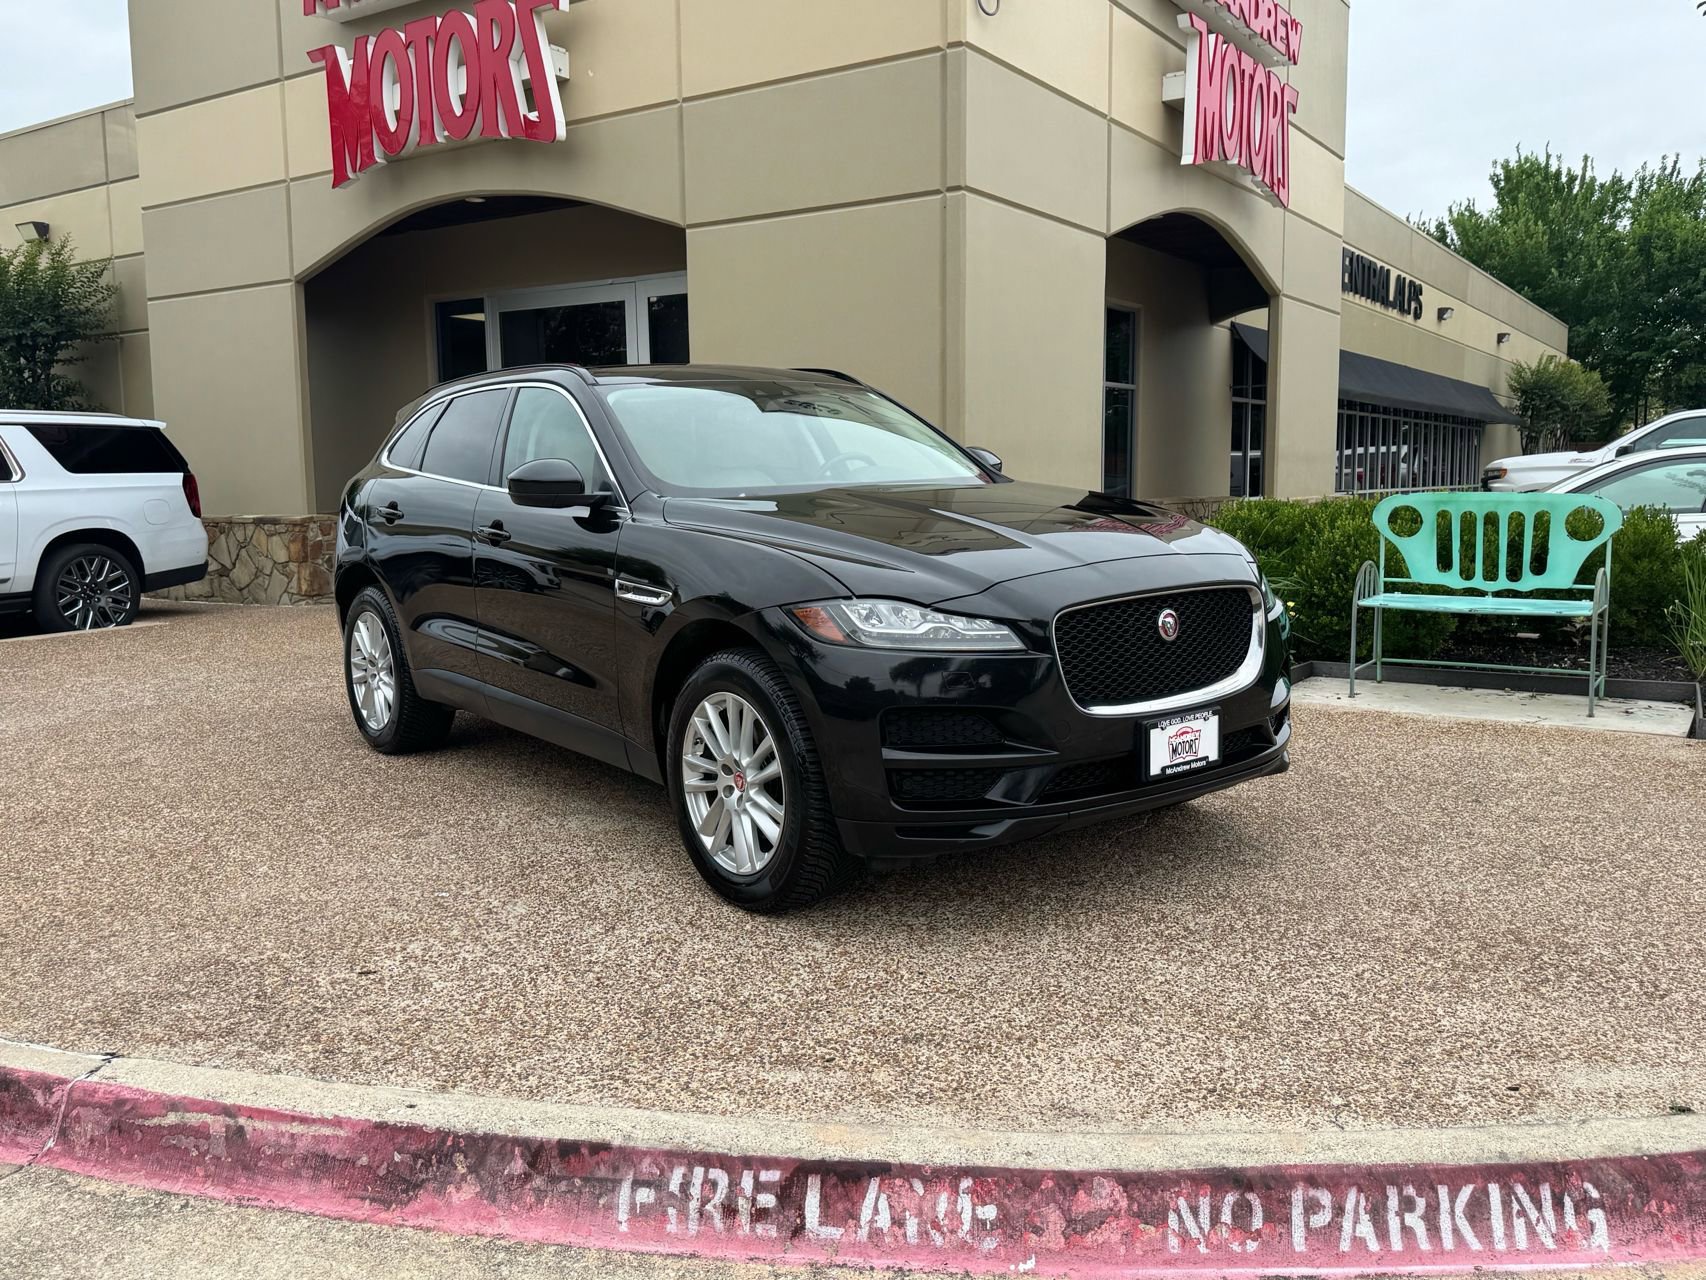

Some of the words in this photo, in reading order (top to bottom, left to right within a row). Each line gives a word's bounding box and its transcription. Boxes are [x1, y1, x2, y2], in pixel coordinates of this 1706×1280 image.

[306, 0, 567, 189] MOTORS
[1188, 12, 1300, 208] MOTORS
[1341, 246, 1398, 311] ENTRAL
[1393, 273, 1423, 321] ALPS
[1157, 719, 1171, 728] LOVE
[1182, 713, 1195, 723] LOVE
[1170, 738, 1199, 760] MOTORS
[1165, 763, 1190, 775] McAndrew
[1190, 760, 1207, 769] Motors
[1168, 1189, 1264, 1254] NO
[1291, 1181, 1611, 1253] PARKING
